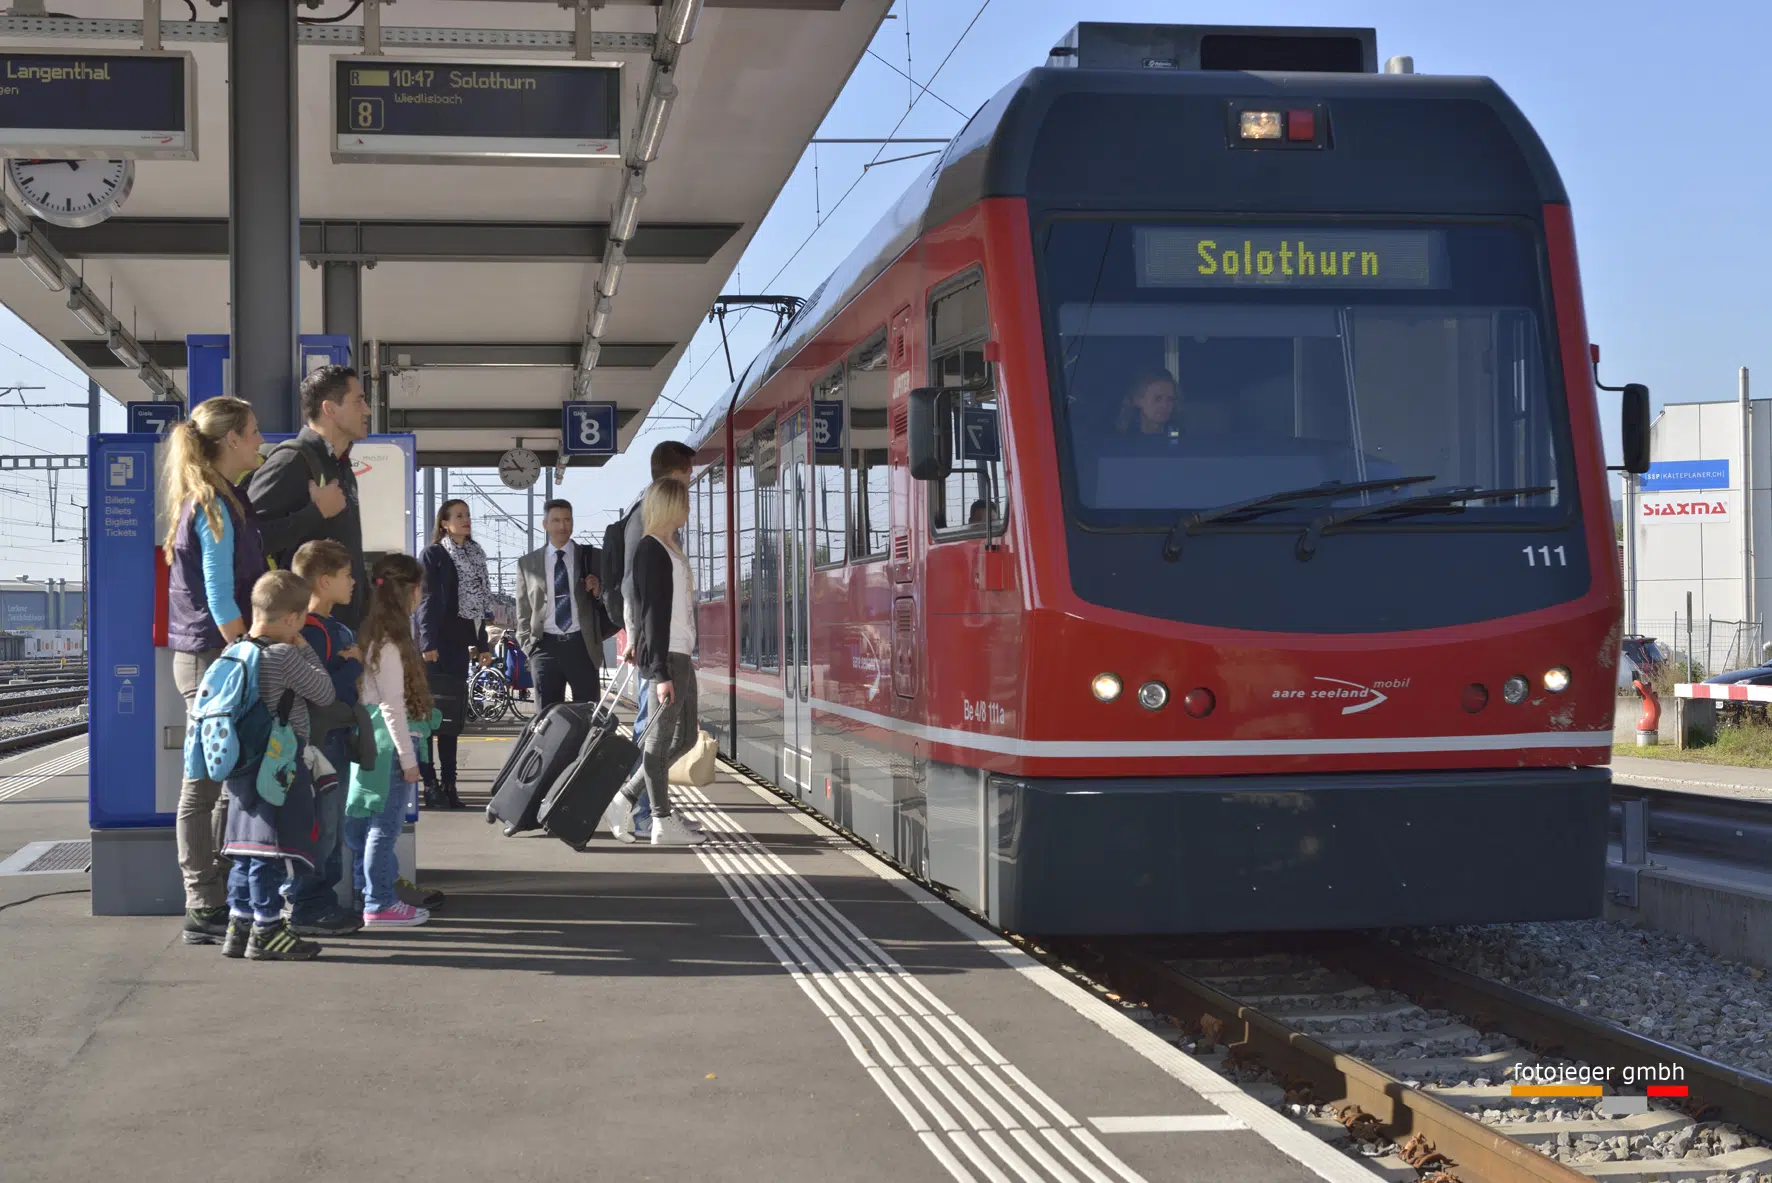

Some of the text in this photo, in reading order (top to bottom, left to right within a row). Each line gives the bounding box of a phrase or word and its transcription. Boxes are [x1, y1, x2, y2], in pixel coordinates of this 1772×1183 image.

[6, 60, 111, 83] Langenthal
[392, 69, 435, 88] 10:47
[450, 71, 537, 90] Solothurn
[394, 92, 463, 105] Wiedlisbach
[358, 101, 373, 127] 8
[1197, 239, 1379, 276] Solothurn
[146, 419, 166, 434] 7
[580, 418, 601, 445] 8
[105, 495, 136, 504] Billette
[105, 506, 132, 515] Billets
[105, 516, 138, 528] Biglietti
[105, 528, 137, 537] Tickets
[1522, 545, 1567, 566] 111
[1373, 677, 1411, 689] mobil
[1272, 688, 1370, 698] aare seeland
[963, 699, 974, 721] Be
[974, 699, 987, 723] 4/8
